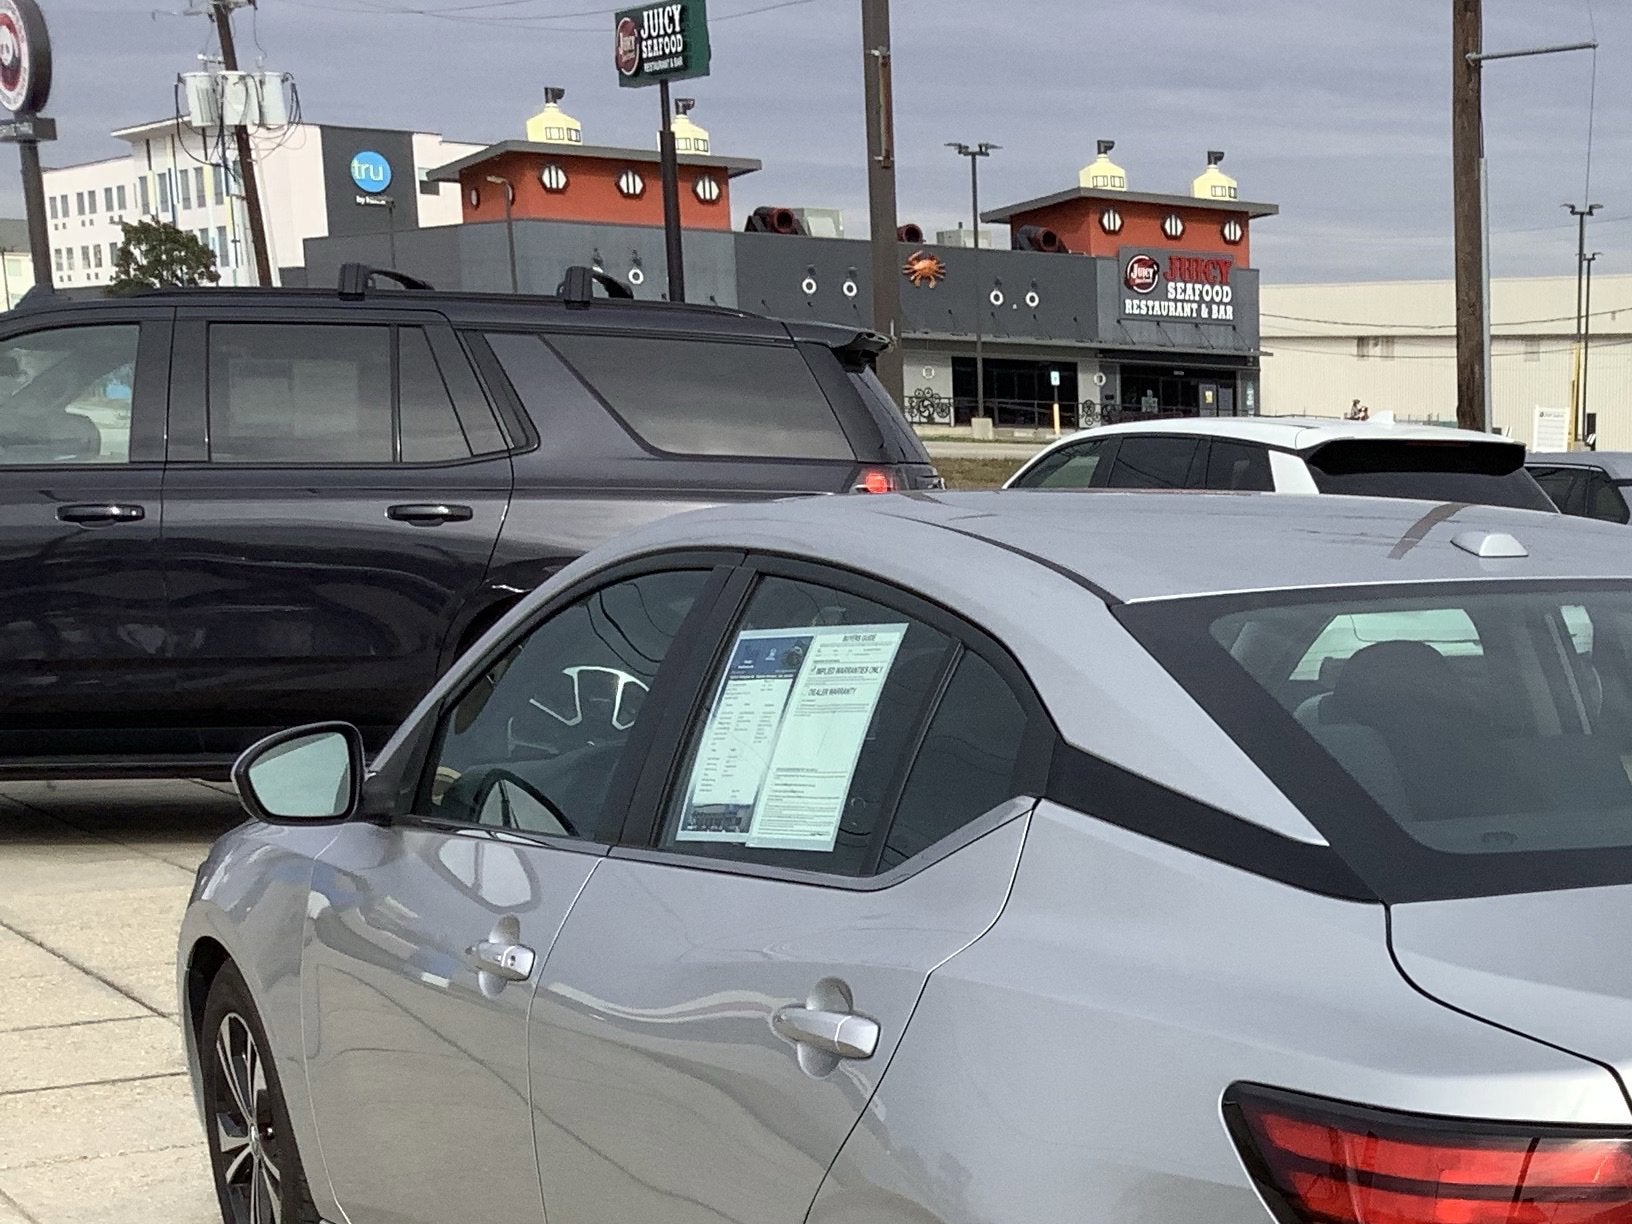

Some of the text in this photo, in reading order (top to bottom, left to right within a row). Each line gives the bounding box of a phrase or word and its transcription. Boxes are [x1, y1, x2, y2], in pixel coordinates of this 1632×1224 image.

[640, 4, 681, 38] JUICY
[641, 33, 683, 58] SEAFOOD
[351, 158, 384, 181] tru
[1163, 256, 1232, 285] JUICY
[1167, 282, 1232, 302] SEAFOOD
[1125, 299, 1233, 320] RESTAURANT & BAR
